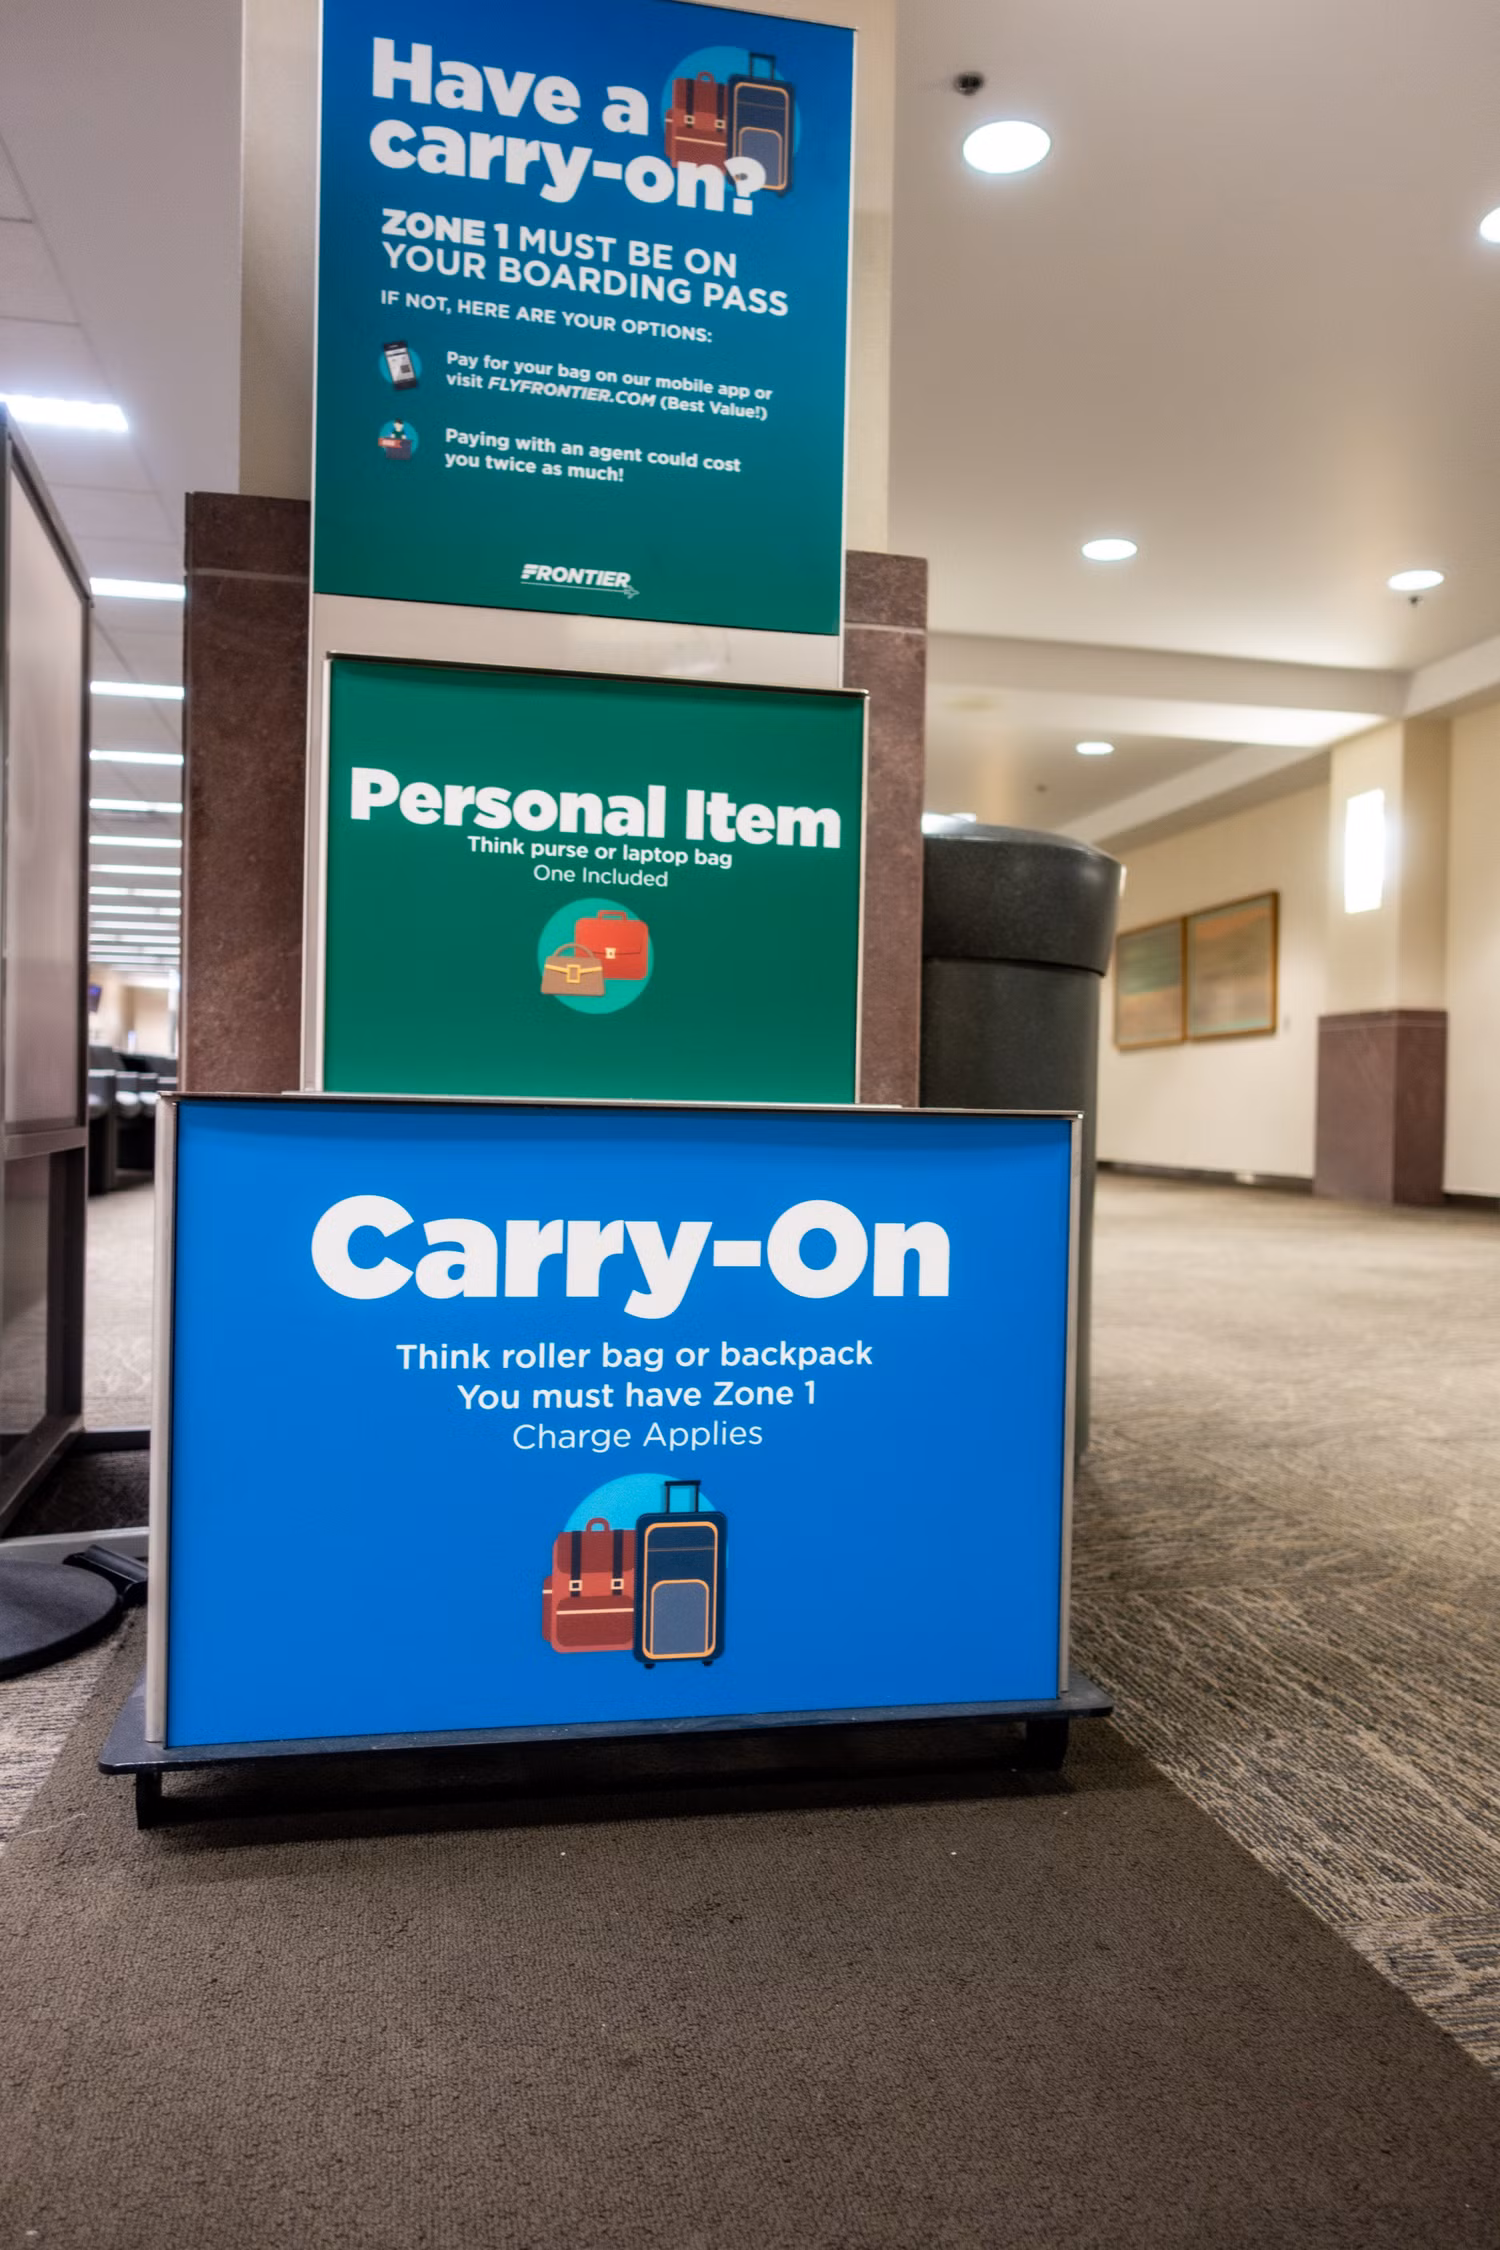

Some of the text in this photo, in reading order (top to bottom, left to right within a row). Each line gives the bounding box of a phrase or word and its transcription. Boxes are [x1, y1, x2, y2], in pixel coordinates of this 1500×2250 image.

[373, 38, 648, 135] Have a
[369, 119, 767, 215] carry-on?
[382, 208, 737, 279] ZONE 1 MUST BE ON
[382, 242, 789, 317] YOUR BOARDING PASS
[381, 289, 712, 343] IF NOT, HERE ARE YOUR OPTIONS:
[446, 372, 768, 421] visit FLYFRONTIER.COM (Best Value!)
[447, 351, 773, 400] Pay for your bag on our mobile app or
[445, 427, 741, 473] Paying with an agent could cost
[445, 452, 624, 482] you twice as much!
[520, 563, 631, 588] FRONTIER
[351, 768, 840, 848] Personal Item
[467, 835, 733, 870] Think purse or laptop bag
[533, 864, 668, 887] One Included
[312, 1195, 950, 1319] Carry-On
[395, 1339, 873, 1373] Think roller bag or backpack
[457, 1380, 815, 1410] You must have Zone 1
[513, 1420, 763, 1453] Charge Applies
